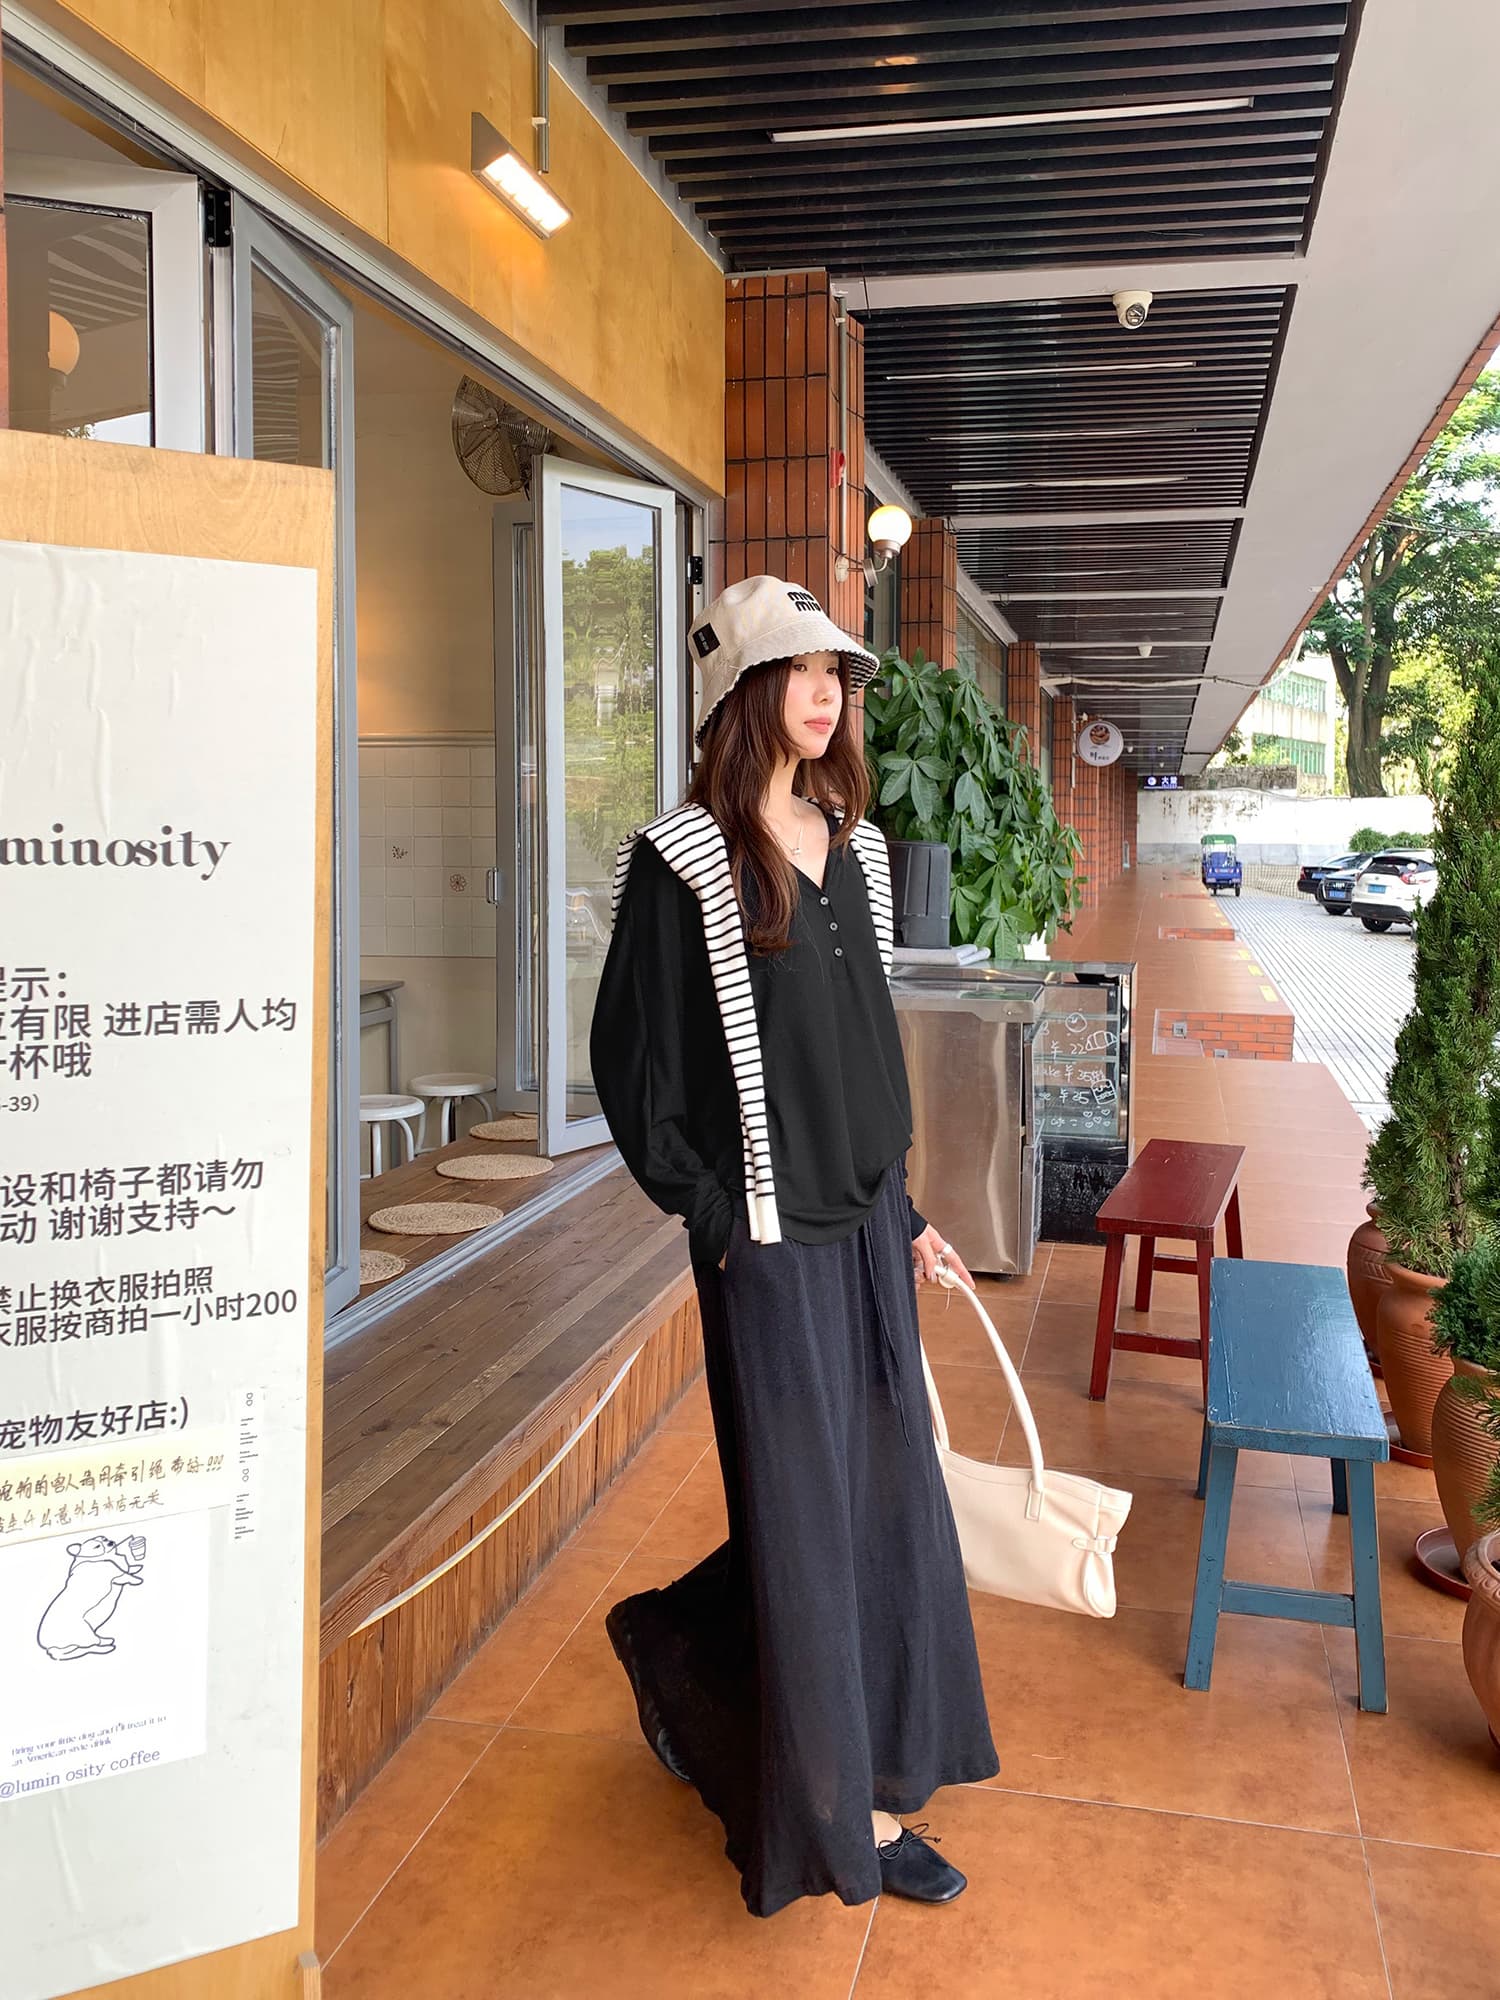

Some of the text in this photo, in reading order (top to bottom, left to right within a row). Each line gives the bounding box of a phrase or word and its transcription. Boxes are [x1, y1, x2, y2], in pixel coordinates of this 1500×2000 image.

[795, 601, 821, 611] miu
[0, 823, 232, 881] minosity
[0, 967, 67, 1002] 示：
[0, 998, 297, 1041] 有限 进店需人均
[0, 1042, 91, 1081] 杯哦
[1070, 1043, 1088, 1055] 22
[0, 1158, 263, 1209] 设和椅子都请勿
[0, 1210, 37, 1244] 动
[0, 1397, 189, 1450] 宠物友好店:)
[0, 1750, 161, 1798] @lumin osity coffee
